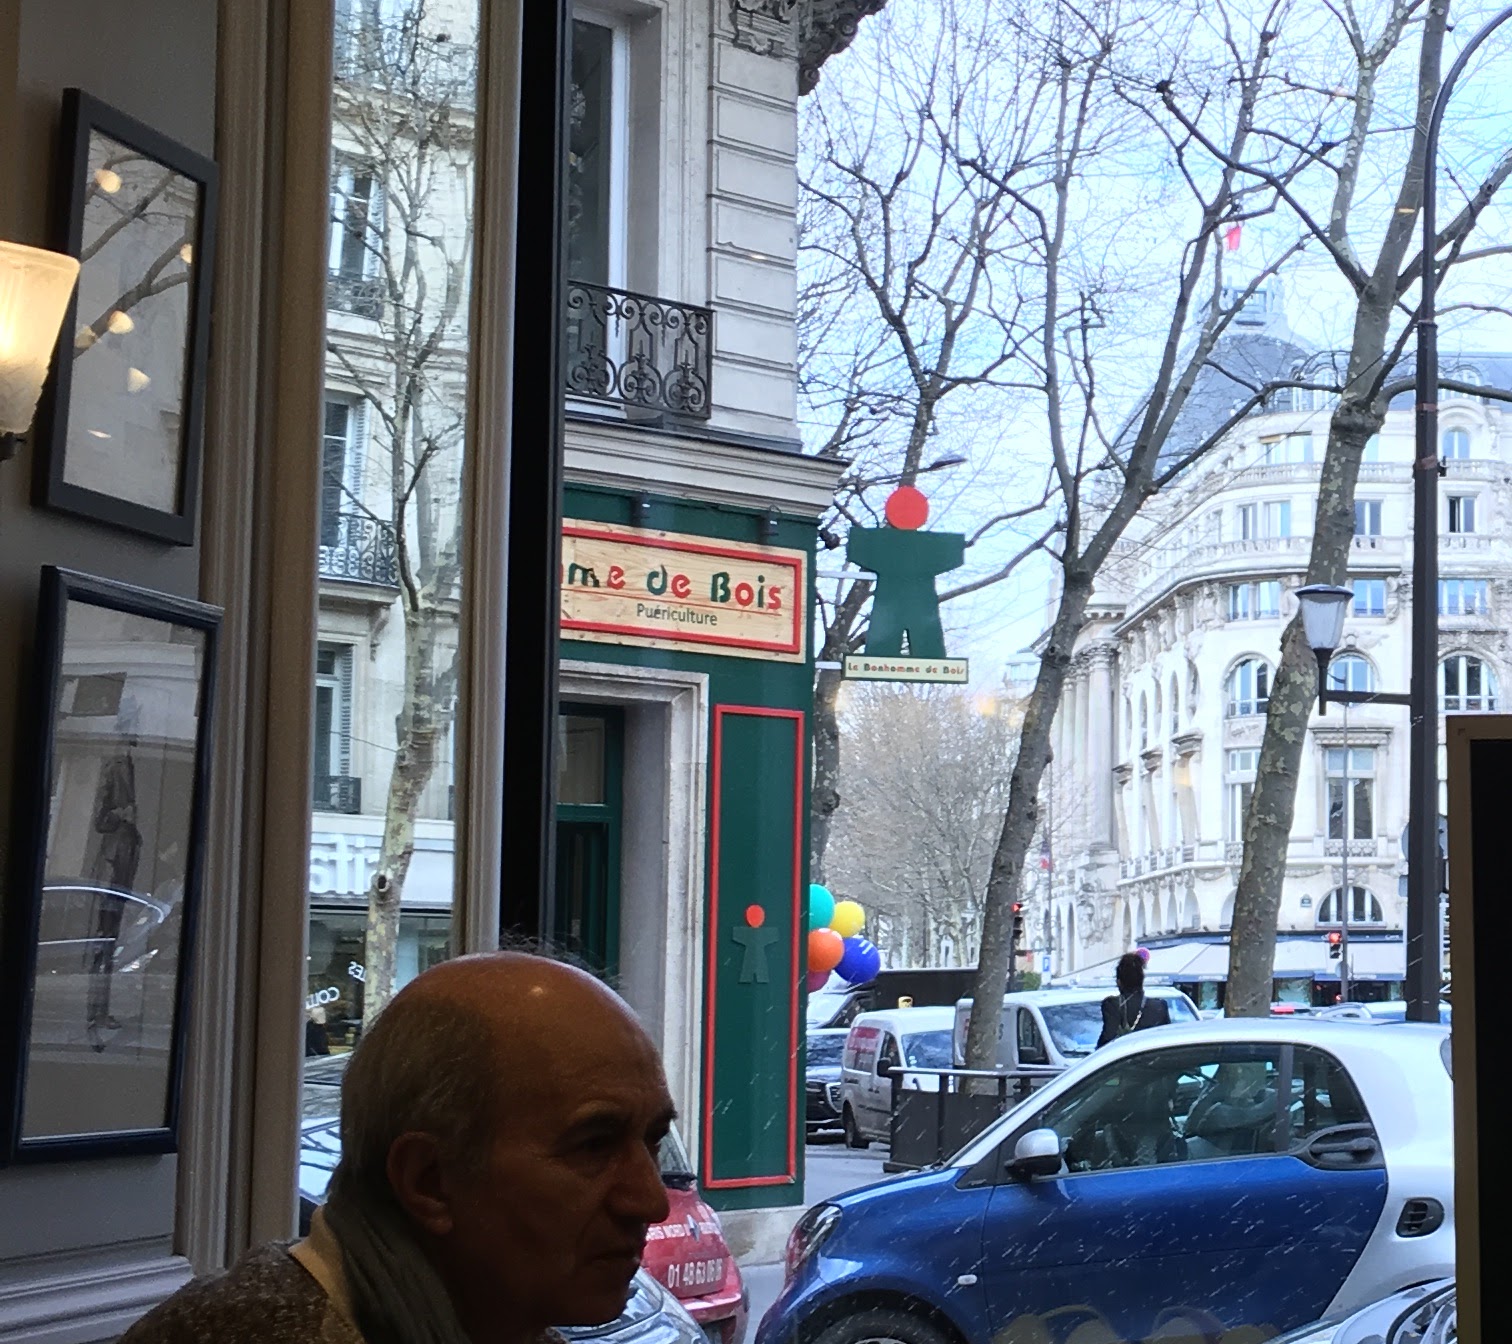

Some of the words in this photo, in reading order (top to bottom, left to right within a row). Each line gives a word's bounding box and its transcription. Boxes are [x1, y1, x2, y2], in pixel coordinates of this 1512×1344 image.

[557, 562, 626, 590] me
[647, 564, 692, 599] de
[711, 571, 783, 610] Bois
[637, 603, 718, 626] Puériculture
[864, 663, 920, 673] Bonhomme
[925, 665, 938, 674] de
[943, 666, 965, 675] Bois
[667, 1263, 680, 1289] 01
